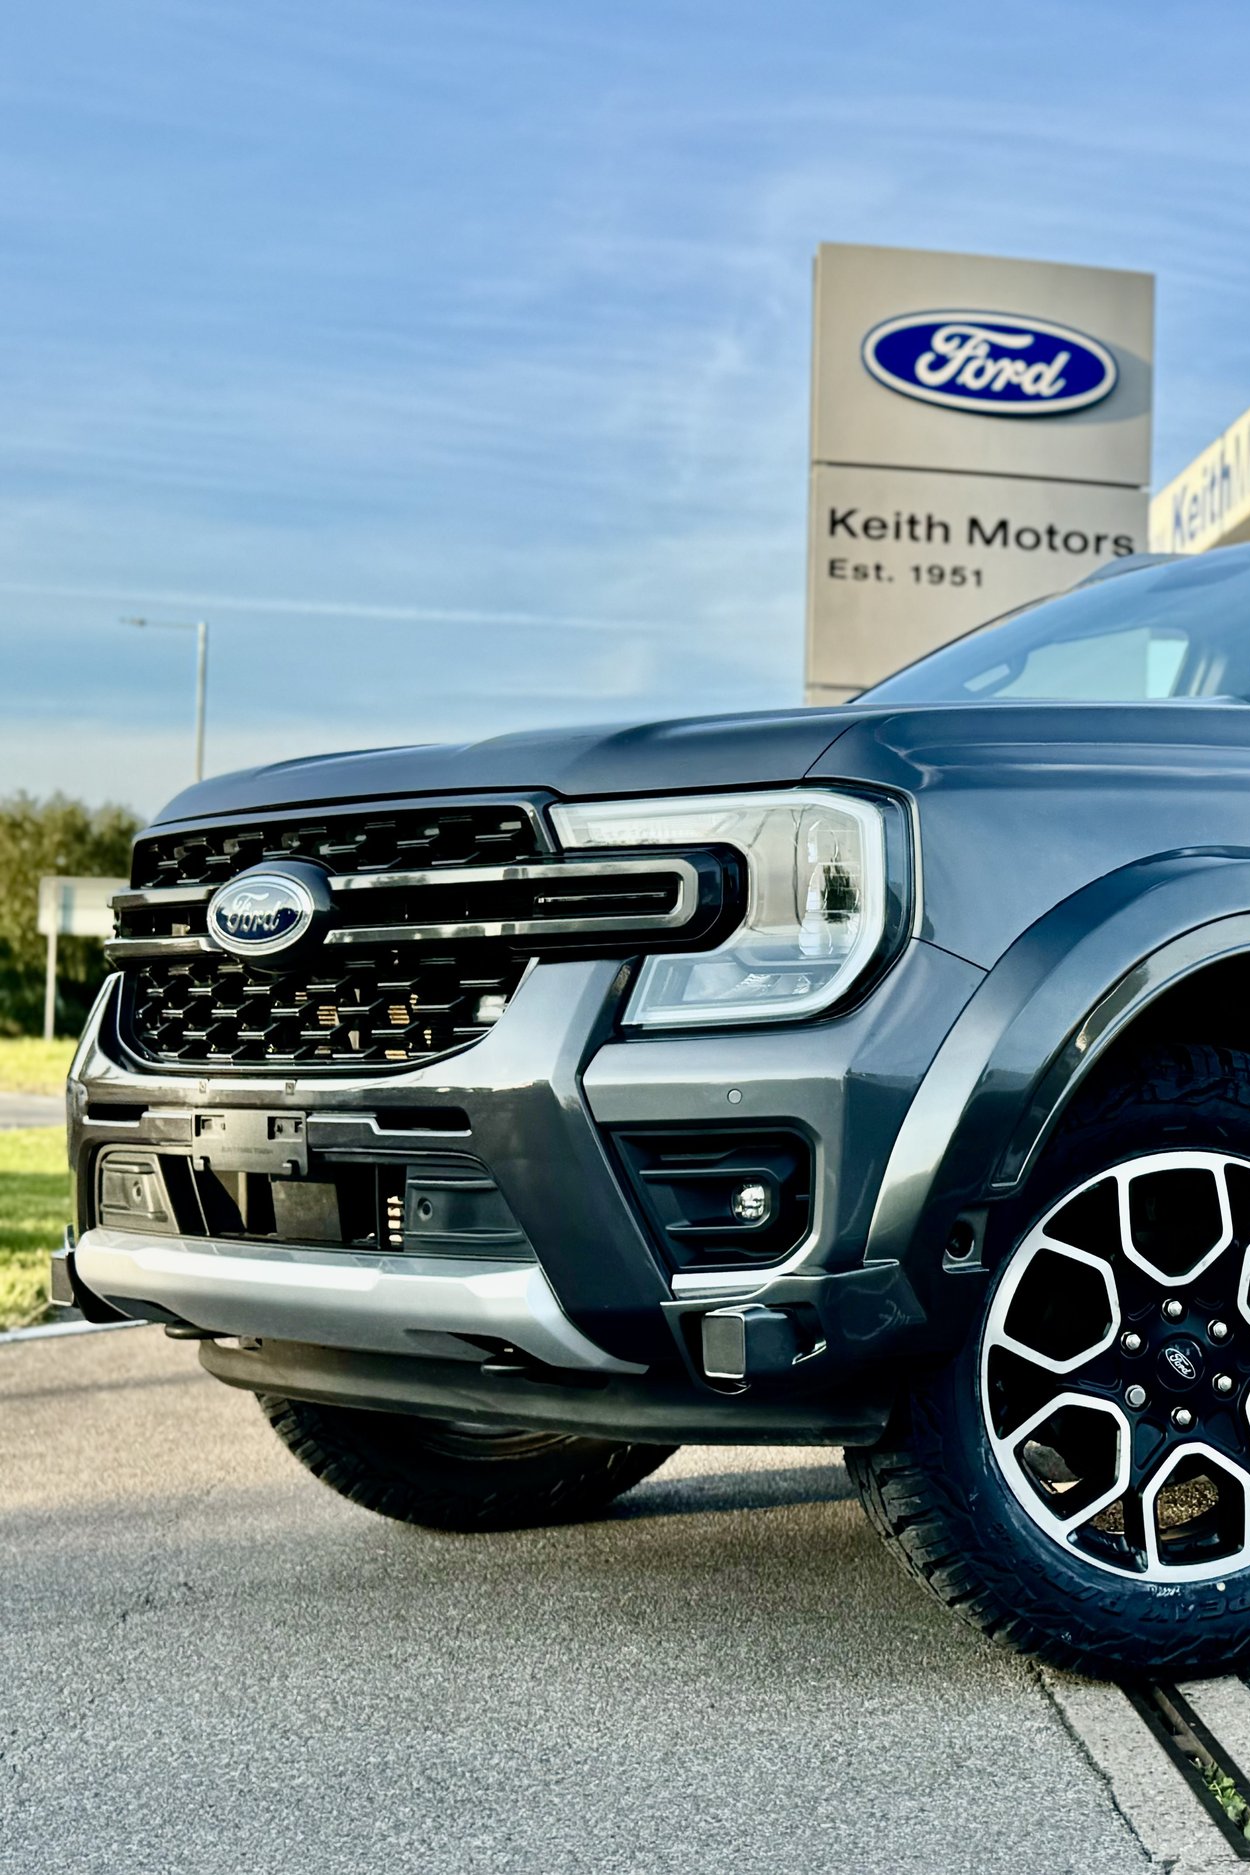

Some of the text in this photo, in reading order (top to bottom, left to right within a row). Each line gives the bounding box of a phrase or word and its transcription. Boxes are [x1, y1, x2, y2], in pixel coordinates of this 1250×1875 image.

[914, 324, 1071, 398] Ford
[827, 506, 1136, 555] Keith Motors
[827, 558, 984, 587] Est. 1951
[226, 892, 281, 934] Ford
[1169, 1352, 1192, 1375] Ford
